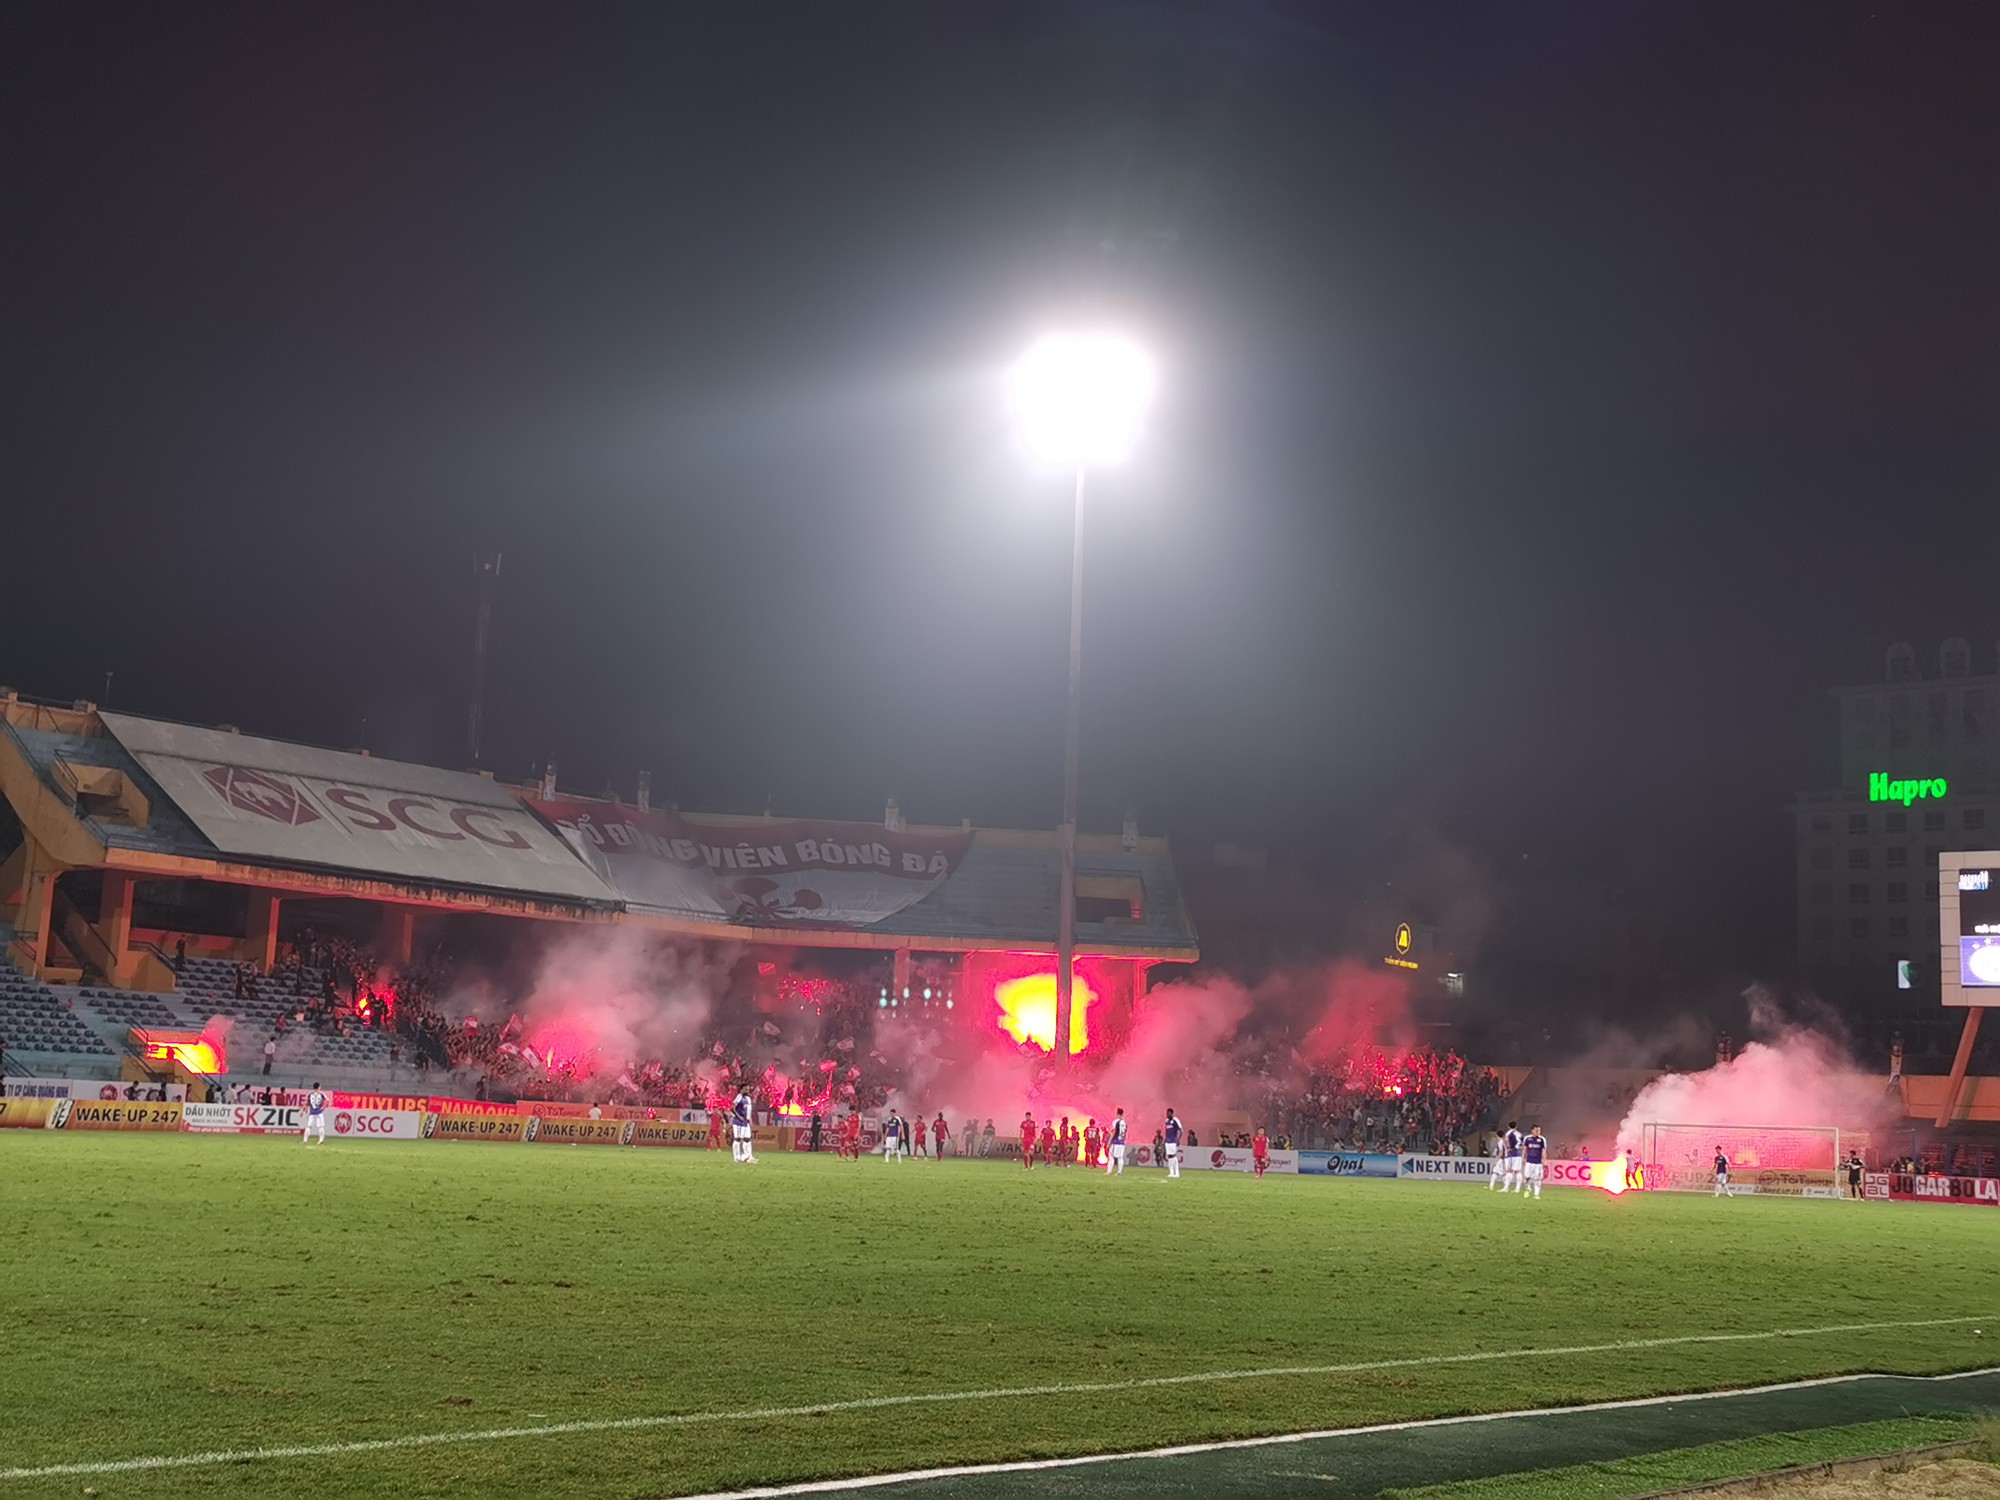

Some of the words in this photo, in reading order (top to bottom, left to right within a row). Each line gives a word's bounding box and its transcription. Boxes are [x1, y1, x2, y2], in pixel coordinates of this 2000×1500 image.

[1869, 772, 1948, 807] Hapro
[325, 787, 533, 850] SCG
[700, 842, 789, 869] VIÊN
[76, 1108, 148, 1122] WAKE-UP
[151, 1110, 179, 1123] 247
[233, 1107, 260, 1127] SK
[261, 1108, 301, 1127] ZIC
[356, 1116, 394, 1133] SCG
[441, 1121, 496, 1134] WAKE-UP
[498, 1123, 520, 1135] 247
[543, 1124, 594, 1137] WAKE-UP
[596, 1126, 617, 1138] 247
[638, 1127, 686, 1140] WAKE-UP
[688, 1131, 707, 1141] 247
[819, 1131, 874, 1149] Kaa
[1052, 1146, 1073, 1156] 27
[1416, 1160, 1450, 1174] NEXT
[1454, 1162, 1491, 1175] MEDI
[1554, 1165, 1592, 1181] SCG
